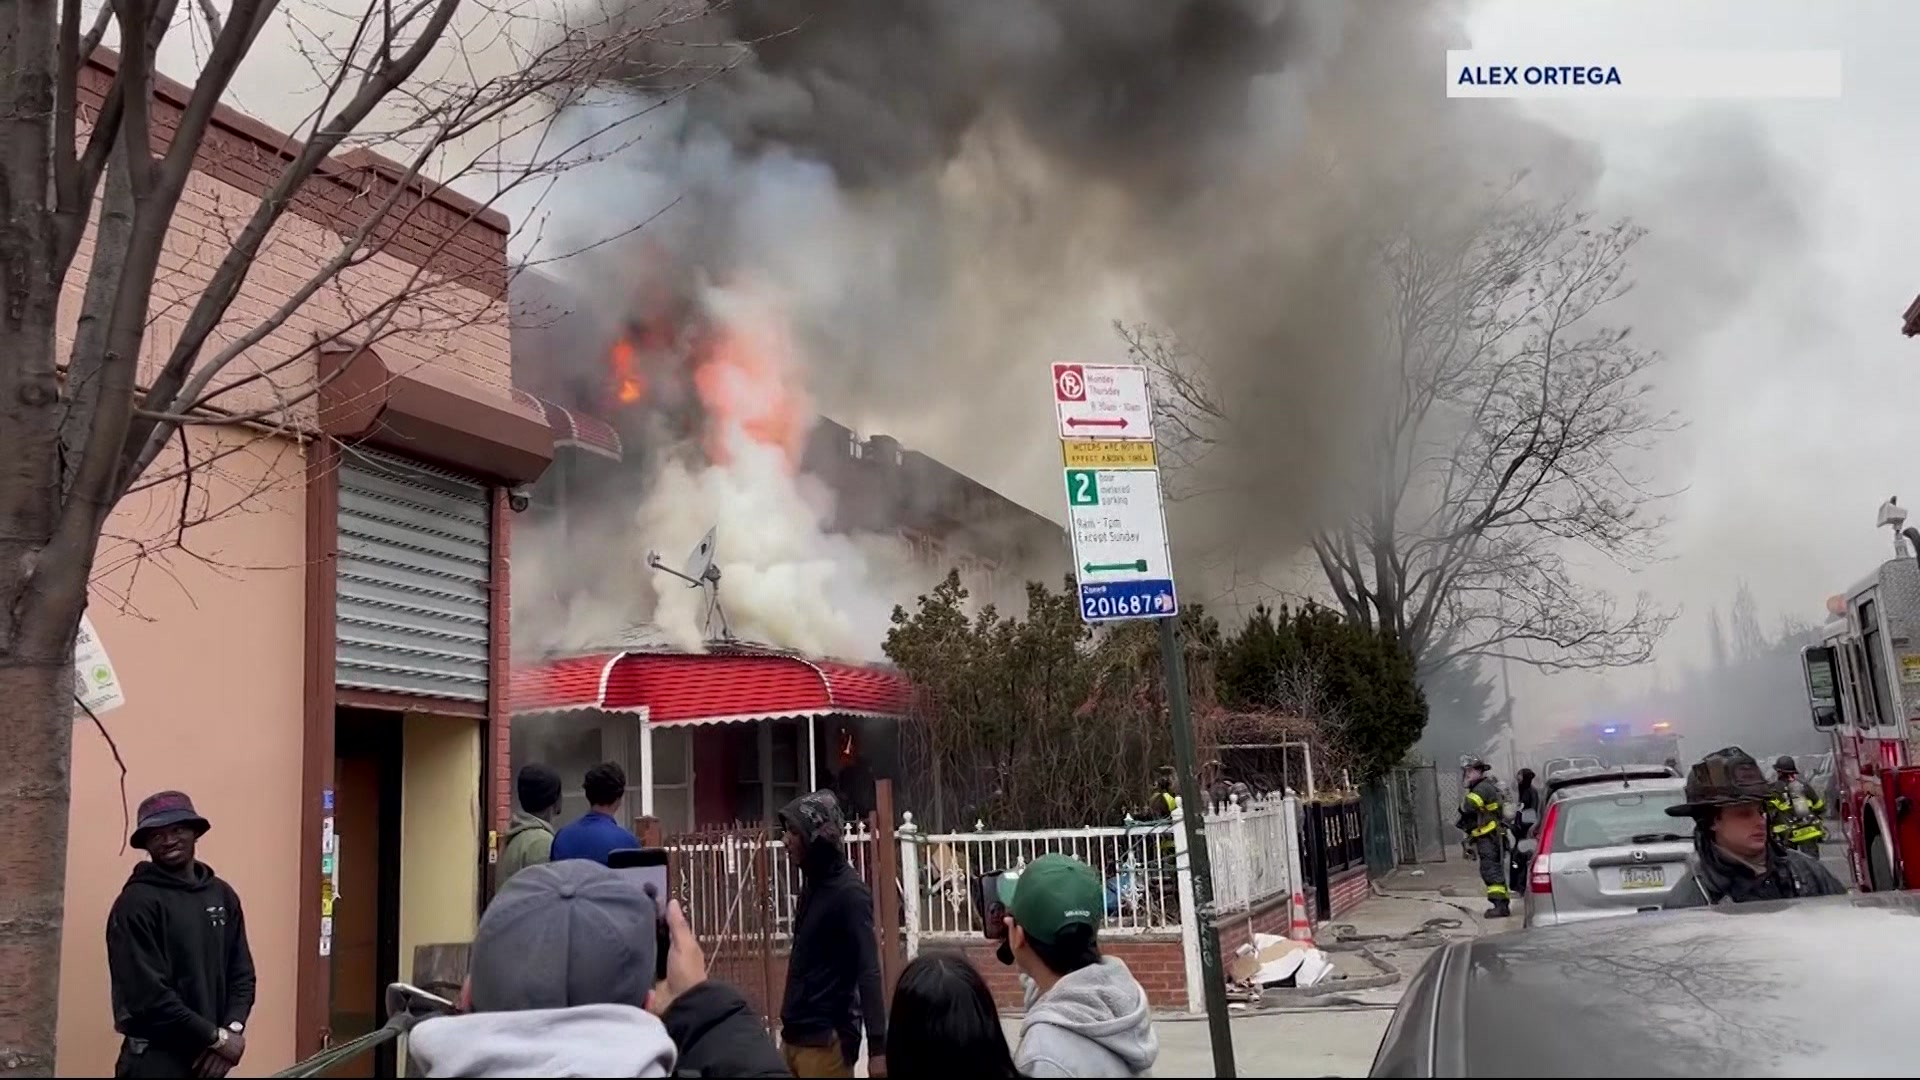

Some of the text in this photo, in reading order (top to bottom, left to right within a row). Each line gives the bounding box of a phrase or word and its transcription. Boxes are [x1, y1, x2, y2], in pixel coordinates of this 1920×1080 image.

[1089, 385, 1120, 397] Thursday
[1075, 473, 1092, 502] 2
[1078, 530, 1140, 543] Except Sunday
[1085, 594, 1152, 616] 201687
